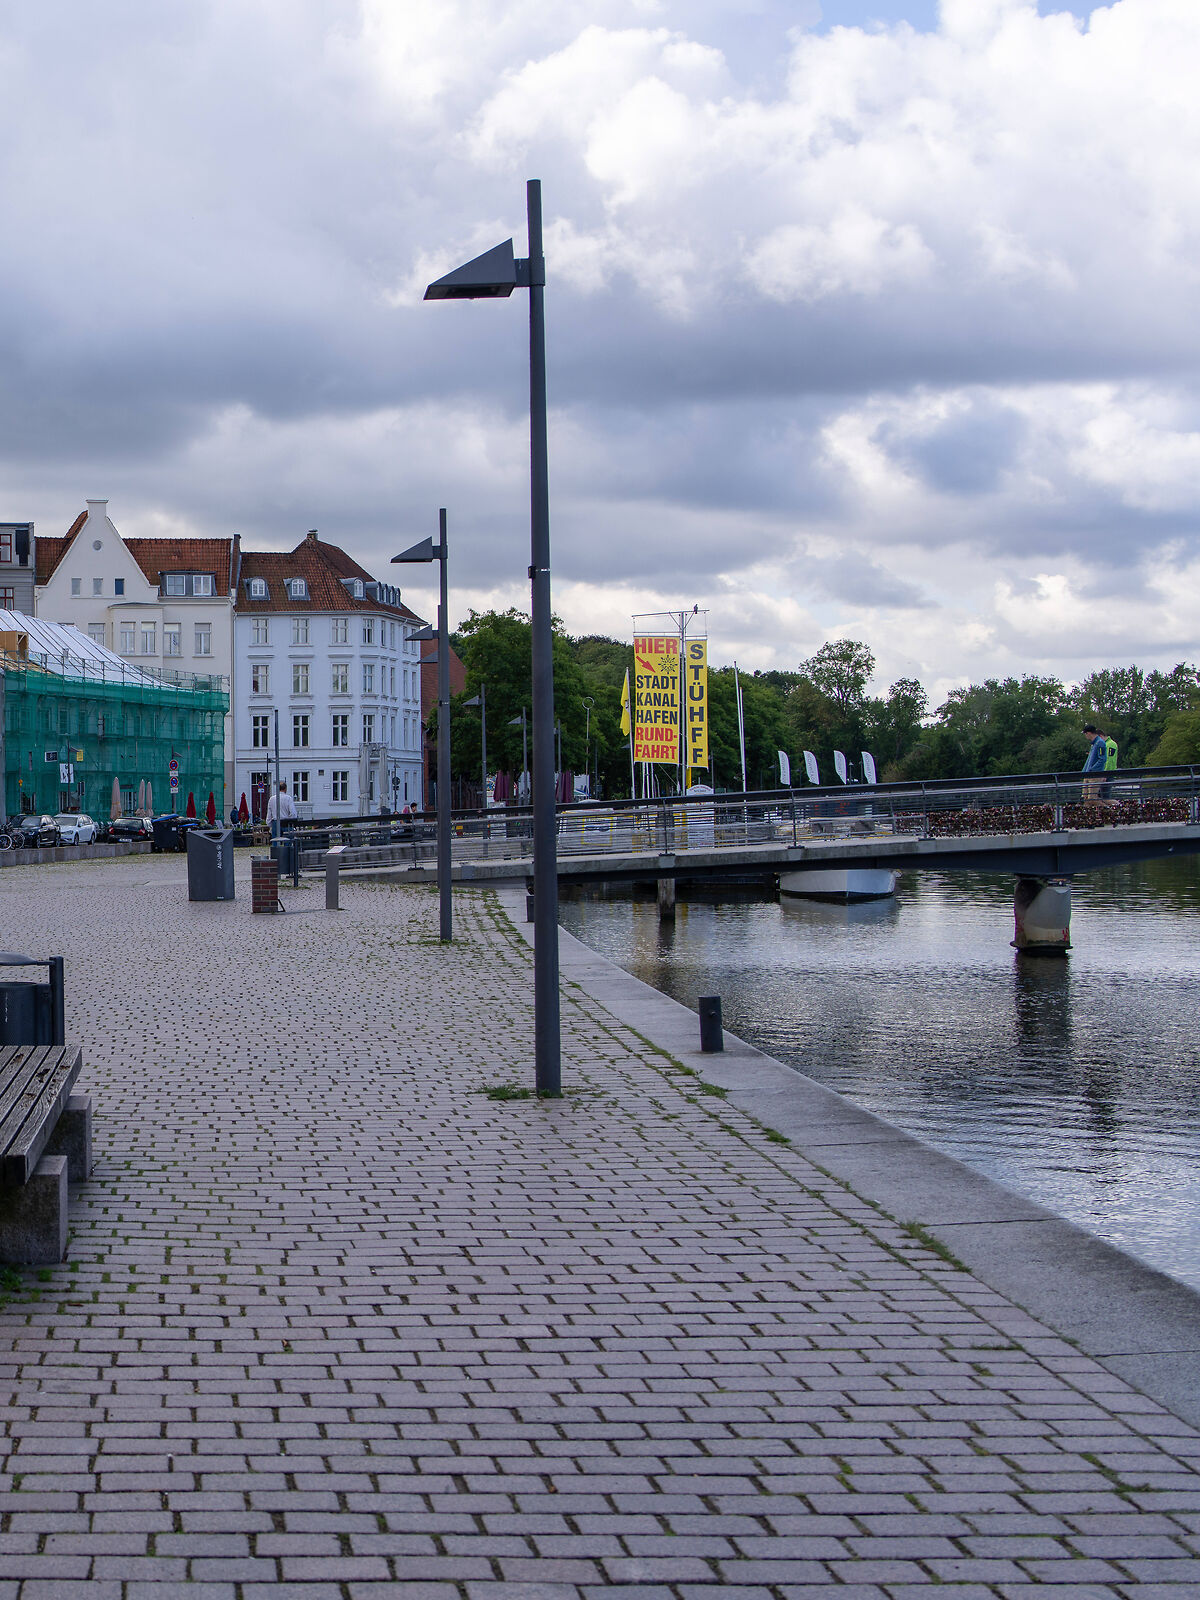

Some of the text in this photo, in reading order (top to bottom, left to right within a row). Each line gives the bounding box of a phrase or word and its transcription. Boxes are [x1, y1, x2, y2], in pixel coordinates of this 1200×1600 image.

[635, 639, 677, 654] HIER
[636, 675, 677, 690] STADT
[636, 693, 677, 707] KANAL
[636, 710, 677, 725] HAFEN
[636, 727, 677, 742] RUND-
[635, 744, 677, 759] FAHRT
